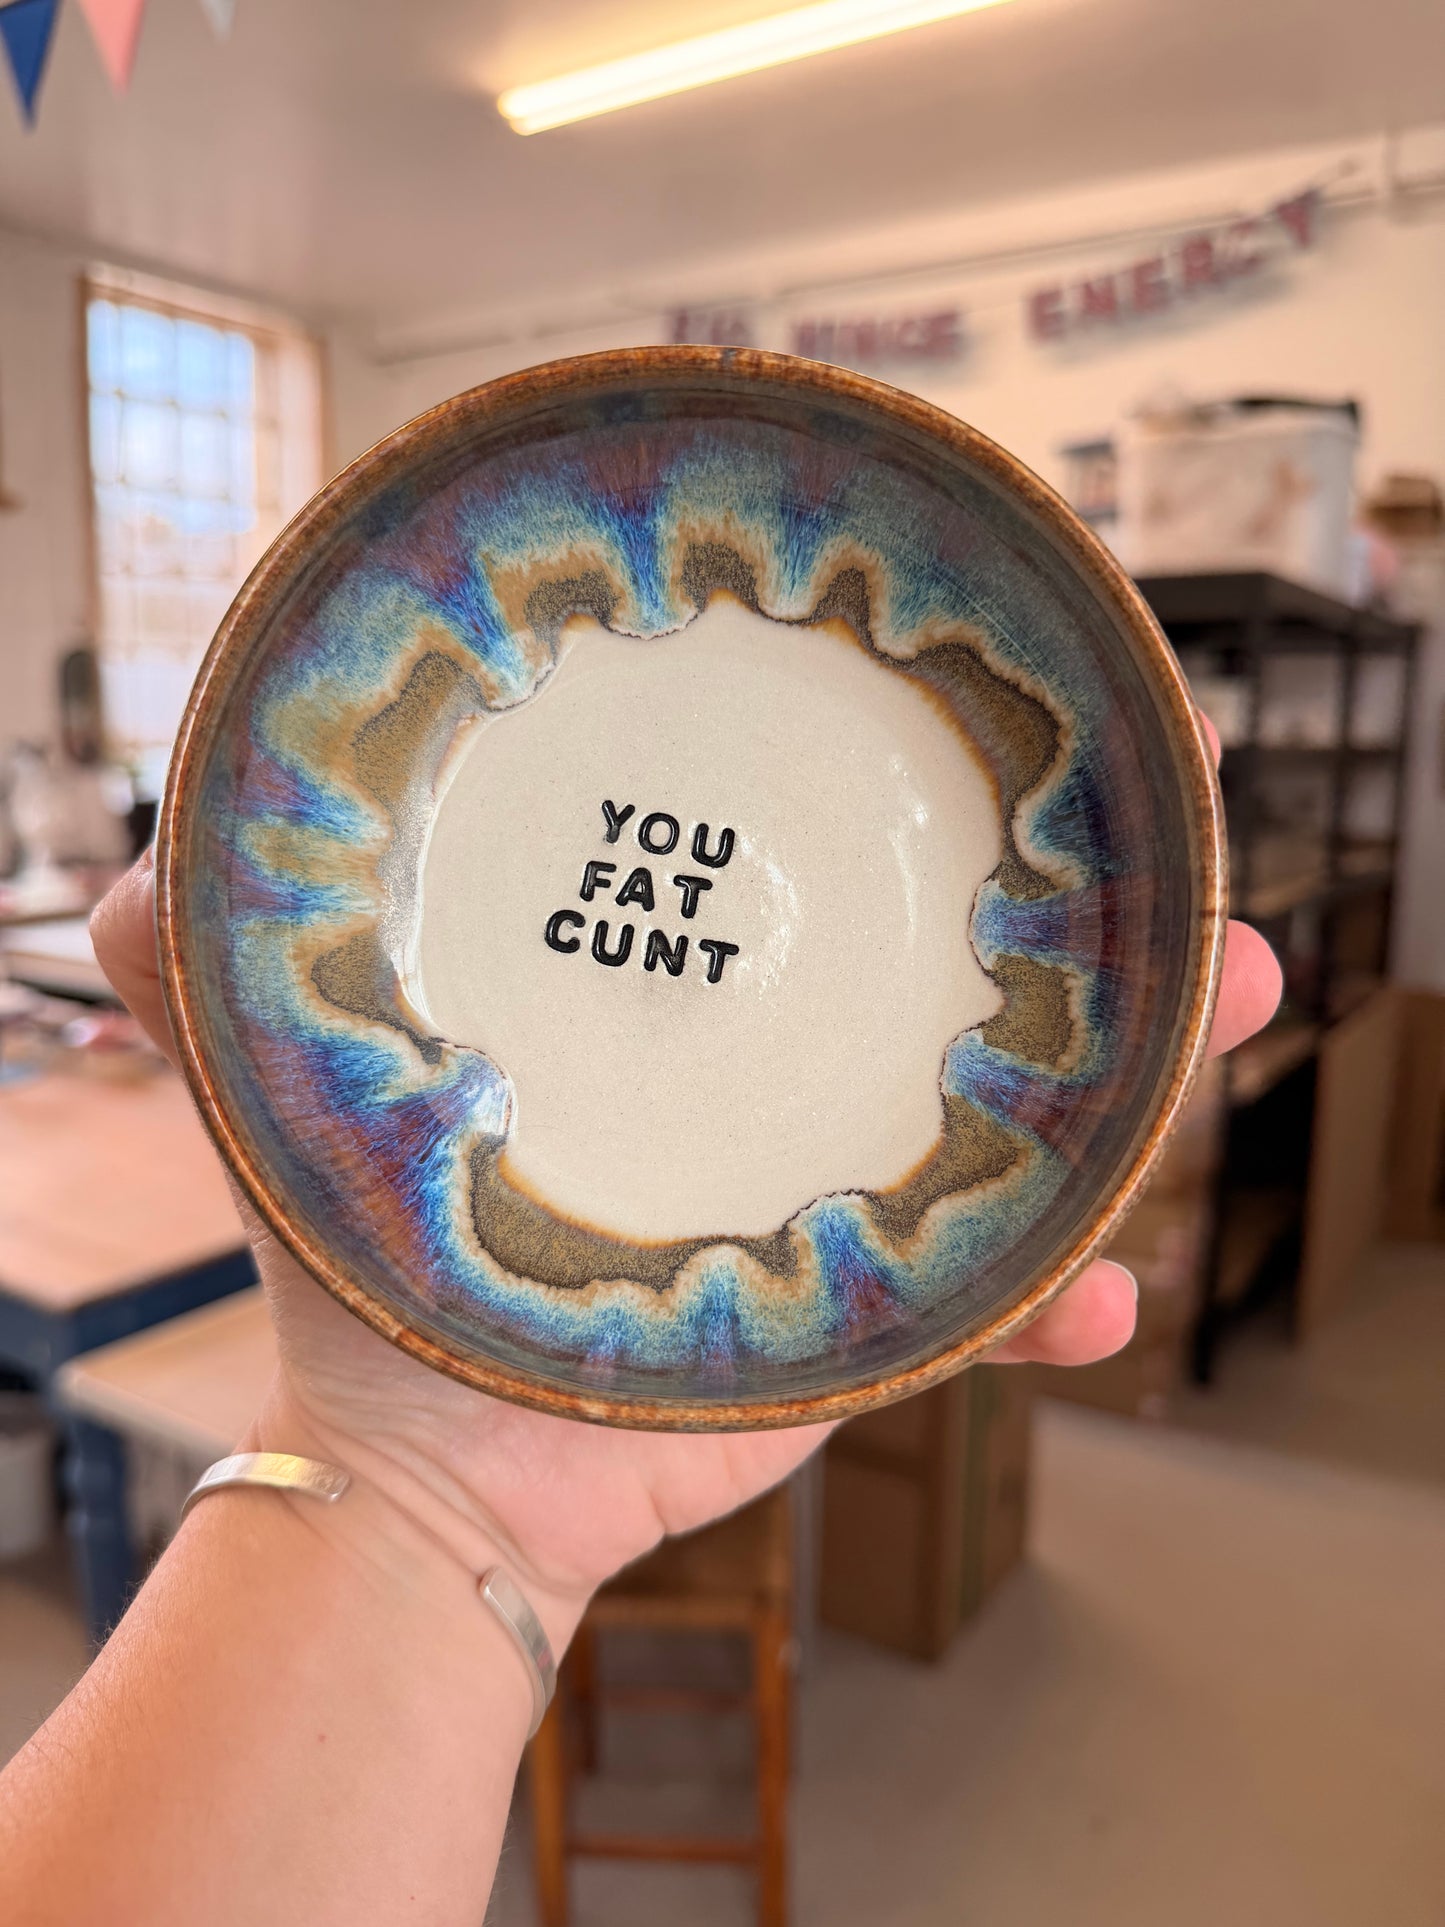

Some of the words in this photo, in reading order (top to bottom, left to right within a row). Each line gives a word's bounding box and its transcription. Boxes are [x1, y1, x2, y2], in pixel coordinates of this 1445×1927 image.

[601, 799, 735, 868] YOU
[579, 860, 713, 918] FAT
[544, 909, 739, 983] CUNT
